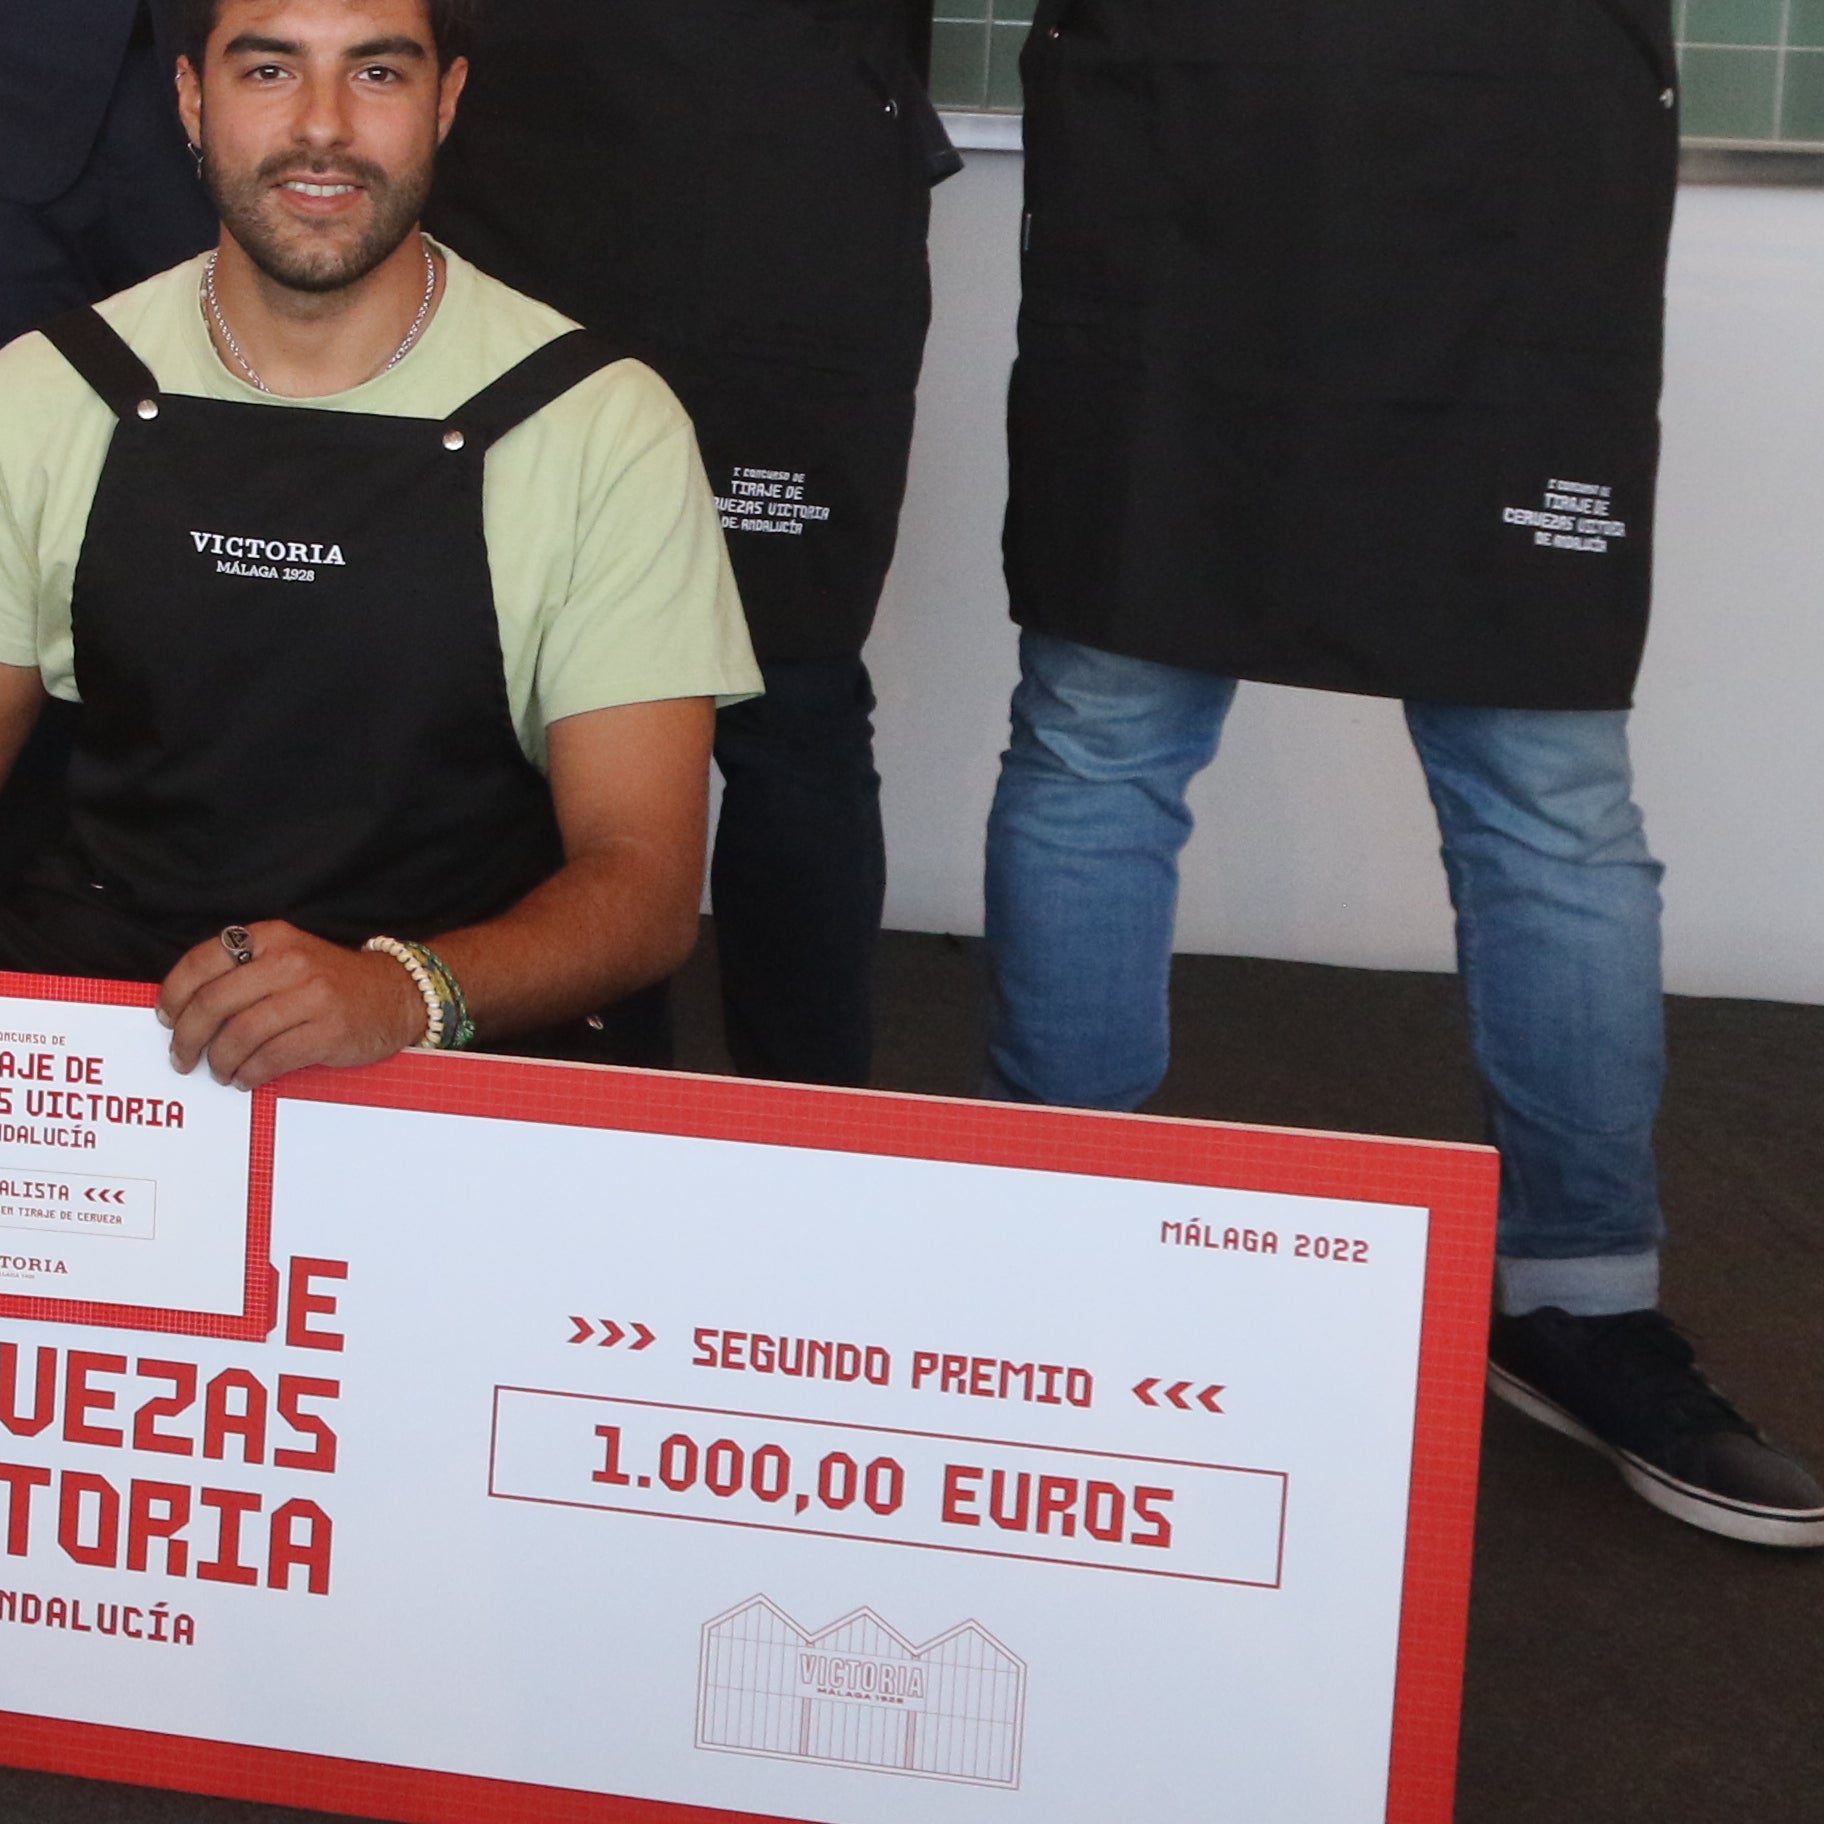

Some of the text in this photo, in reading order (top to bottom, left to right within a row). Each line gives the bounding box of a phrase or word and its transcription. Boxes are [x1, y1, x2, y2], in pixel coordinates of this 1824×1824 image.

[190, 531, 345, 565] VICTORIA
[216, 560, 315, 581] MÁLAGA 1928
[66, 1055, 104, 1085] DE
[26, 1089, 185, 1128] VICTORIA
[1159, 1217, 1369, 1264] MÁLAGA 2022
[692, 1326, 1093, 1408] SEGUNDO PREMIO
[592, 1423, 1175, 1549] 1.000,00 EUROS
[800, 1654, 924, 1698] VICTORIA
